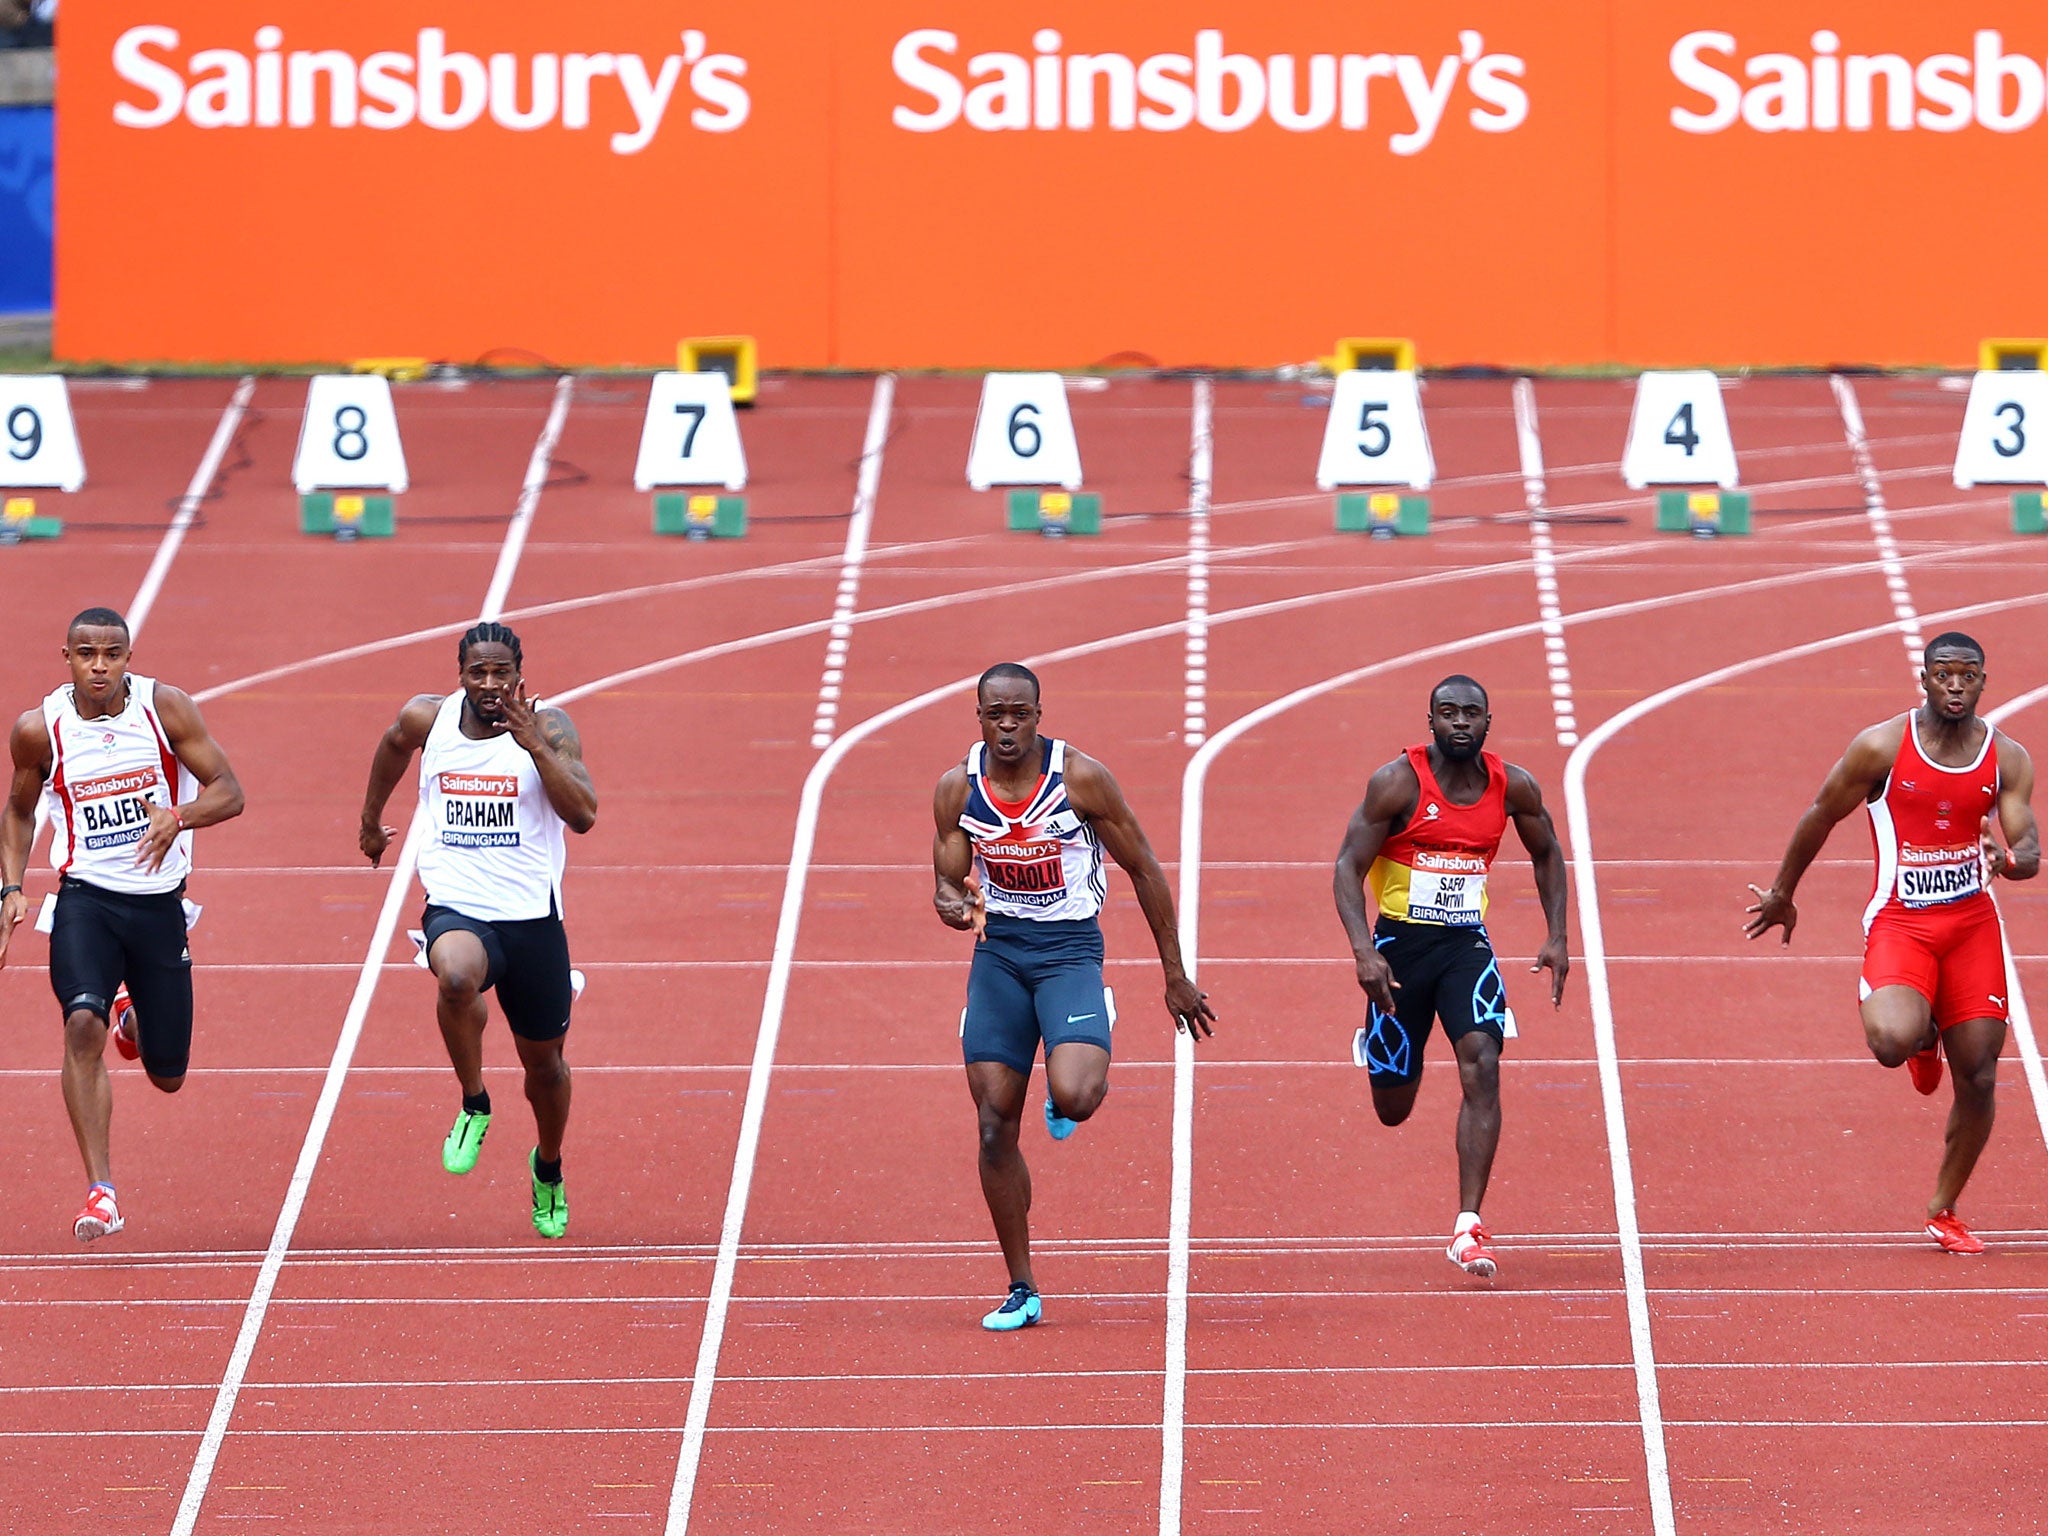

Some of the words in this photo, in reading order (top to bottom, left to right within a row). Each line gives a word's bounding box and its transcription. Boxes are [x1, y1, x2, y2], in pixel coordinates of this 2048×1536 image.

[112, 25, 752, 155] Sainsbury's
[890, 28, 1530, 156] Sainsbury's
[1669, 29, 2048, 134] Sainsb
[7, 405, 42, 461] 9
[334, 406, 368, 461] 8
[675, 405, 706, 458] 7
[1008, 403, 1041, 458] 6
[1358, 403, 1391, 458] 5
[1665, 403, 1699, 456] 4
[1993, 402, 2025, 457] 3
[75, 771, 154, 798] Sainsbury's
[441, 775, 515, 795] Sainsbury's
[88, 826, 149, 848] BIRMINGH
[443, 832, 518, 846] BIRMINGHAM
[446, 799, 514, 828] GRAHAM
[979, 841, 1058, 857] Sainsbury's
[1440, 877, 1466, 892] SAFO
[1904, 862, 1973, 896] SWARAY
